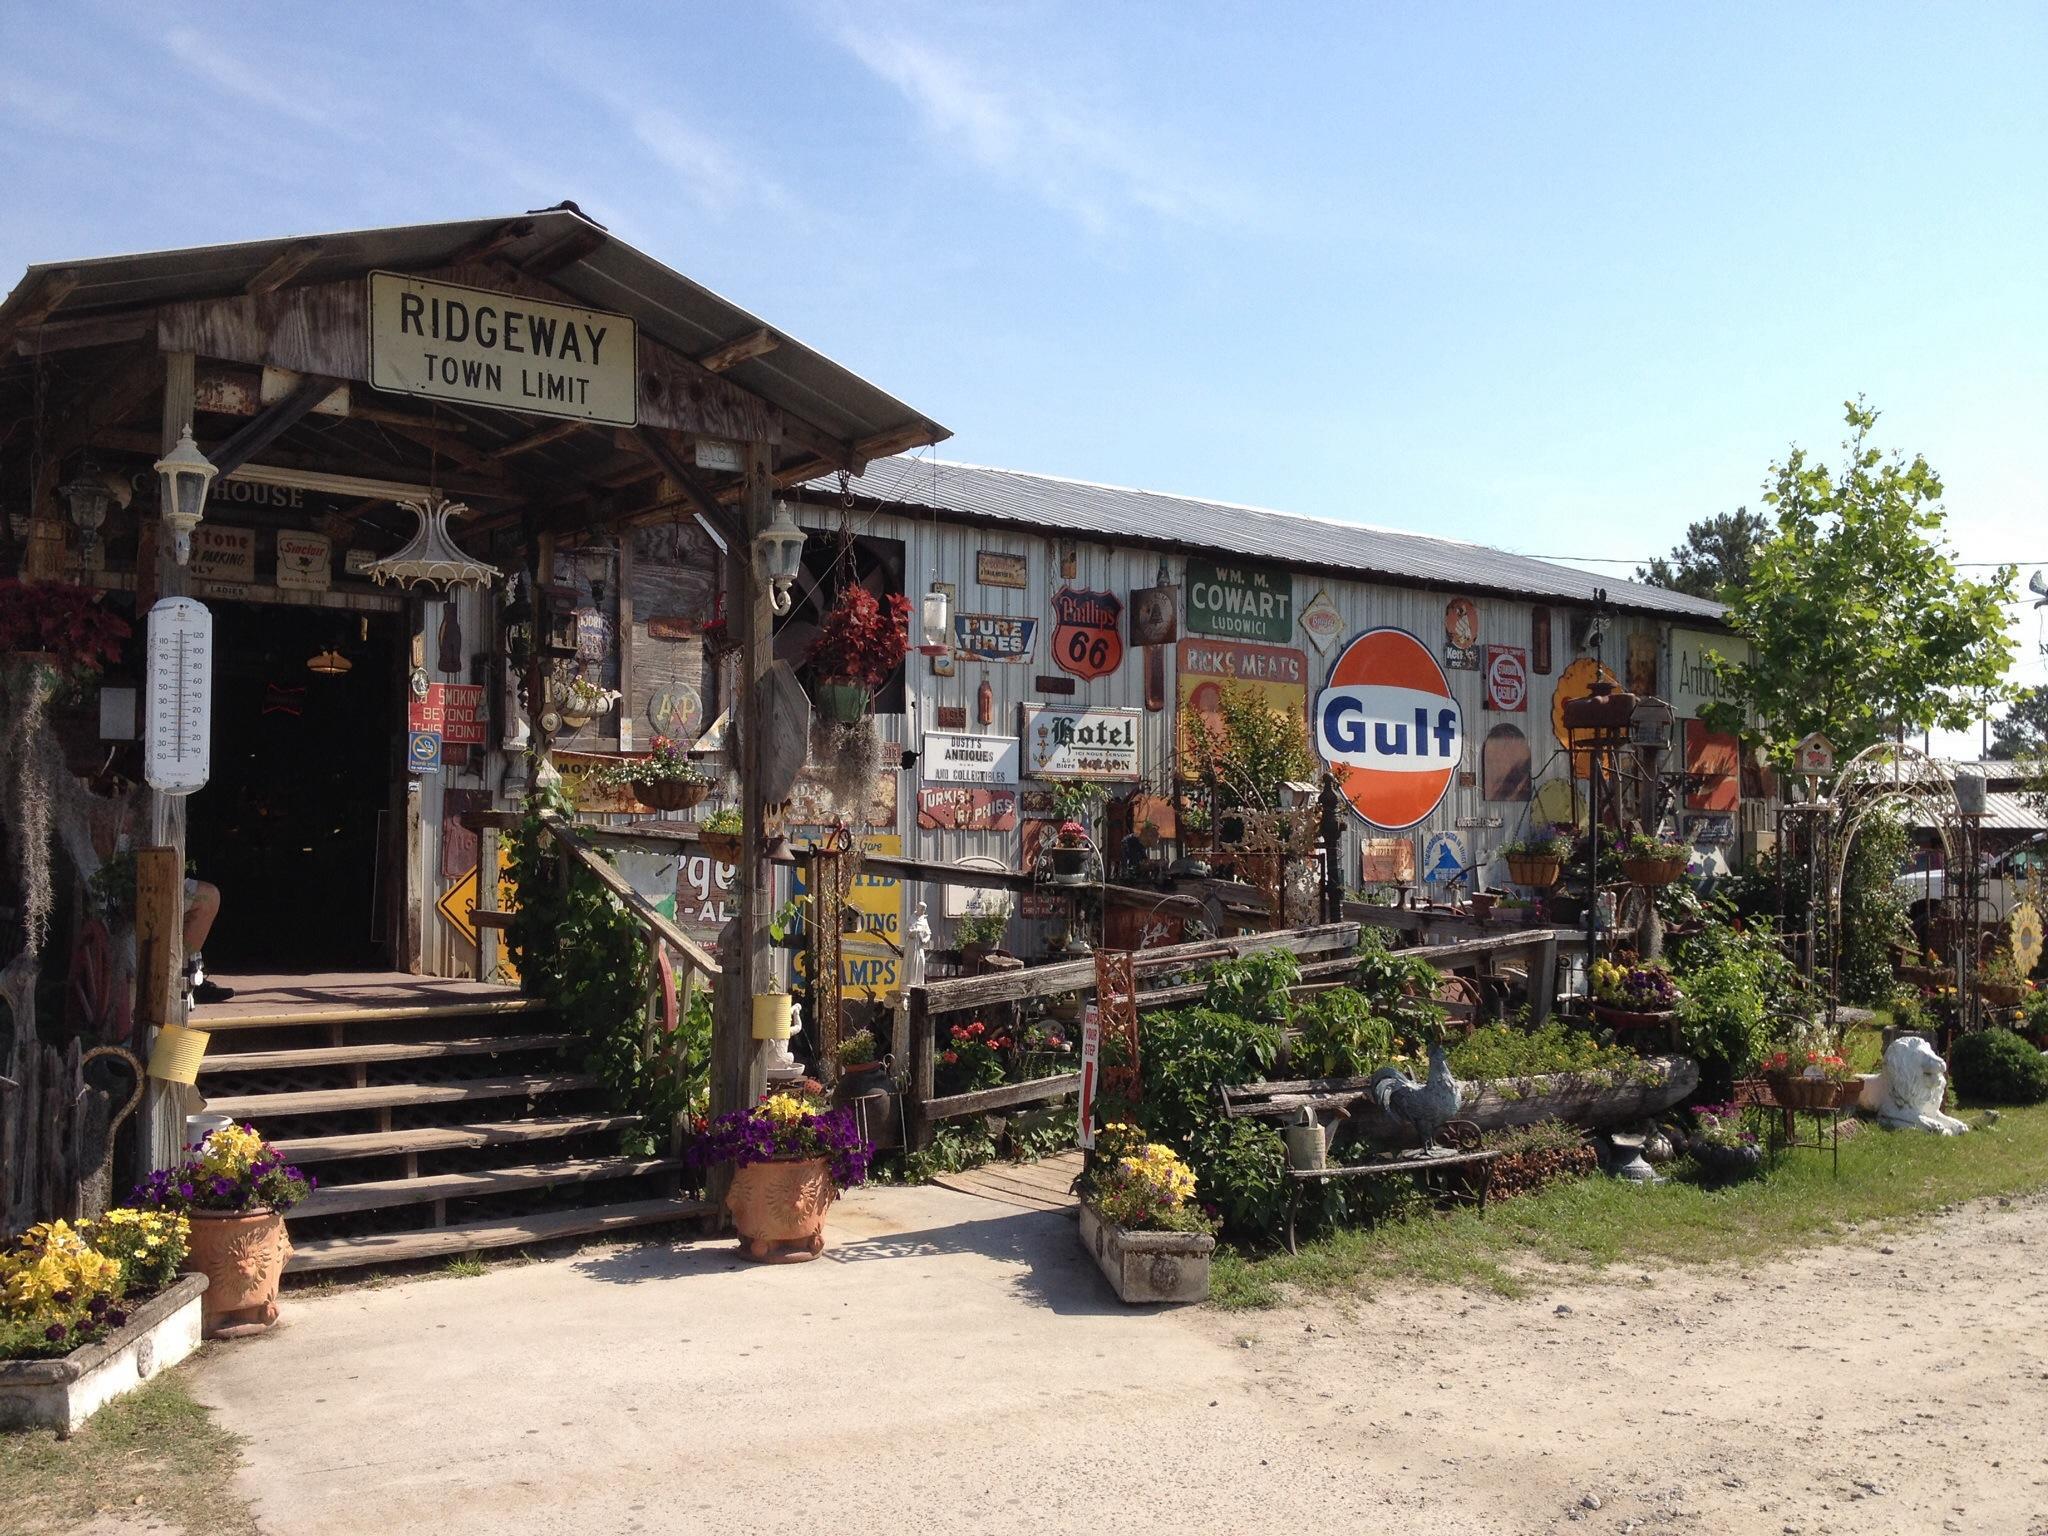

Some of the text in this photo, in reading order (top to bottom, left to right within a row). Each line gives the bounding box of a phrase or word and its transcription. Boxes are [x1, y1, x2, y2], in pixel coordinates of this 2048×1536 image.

[401, 292, 607, 366] RIDGEWAY
[424, 353, 590, 405] TOWN LIMIT
[201, 549, 246, 567] PARKING
[1253, 573, 1269, 588] M.
[1192, 583, 1289, 619] COWART
[1059, 596, 1115, 632] Phillips
[964, 619, 1022, 637] PURE
[1212, 615, 1266, 635] LUDOWICI
[192, 647, 204, 655] 100
[960, 634, 1022, 652] TIRES
[1069, 631, 1109, 669] 66
[1241, 653, 1299, 681] MEATS
[192, 706, 202, 714] 20
[423, 707, 474, 722] BEYOND
[412, 722, 484, 738] THIS POINT
[1051, 716, 1134, 753] Hotel
[1322, 695, 1457, 758] Gulf
[945, 749, 994, 762] ANTIQUES
[935, 769, 1005, 783] AND COLLECTIBLES
